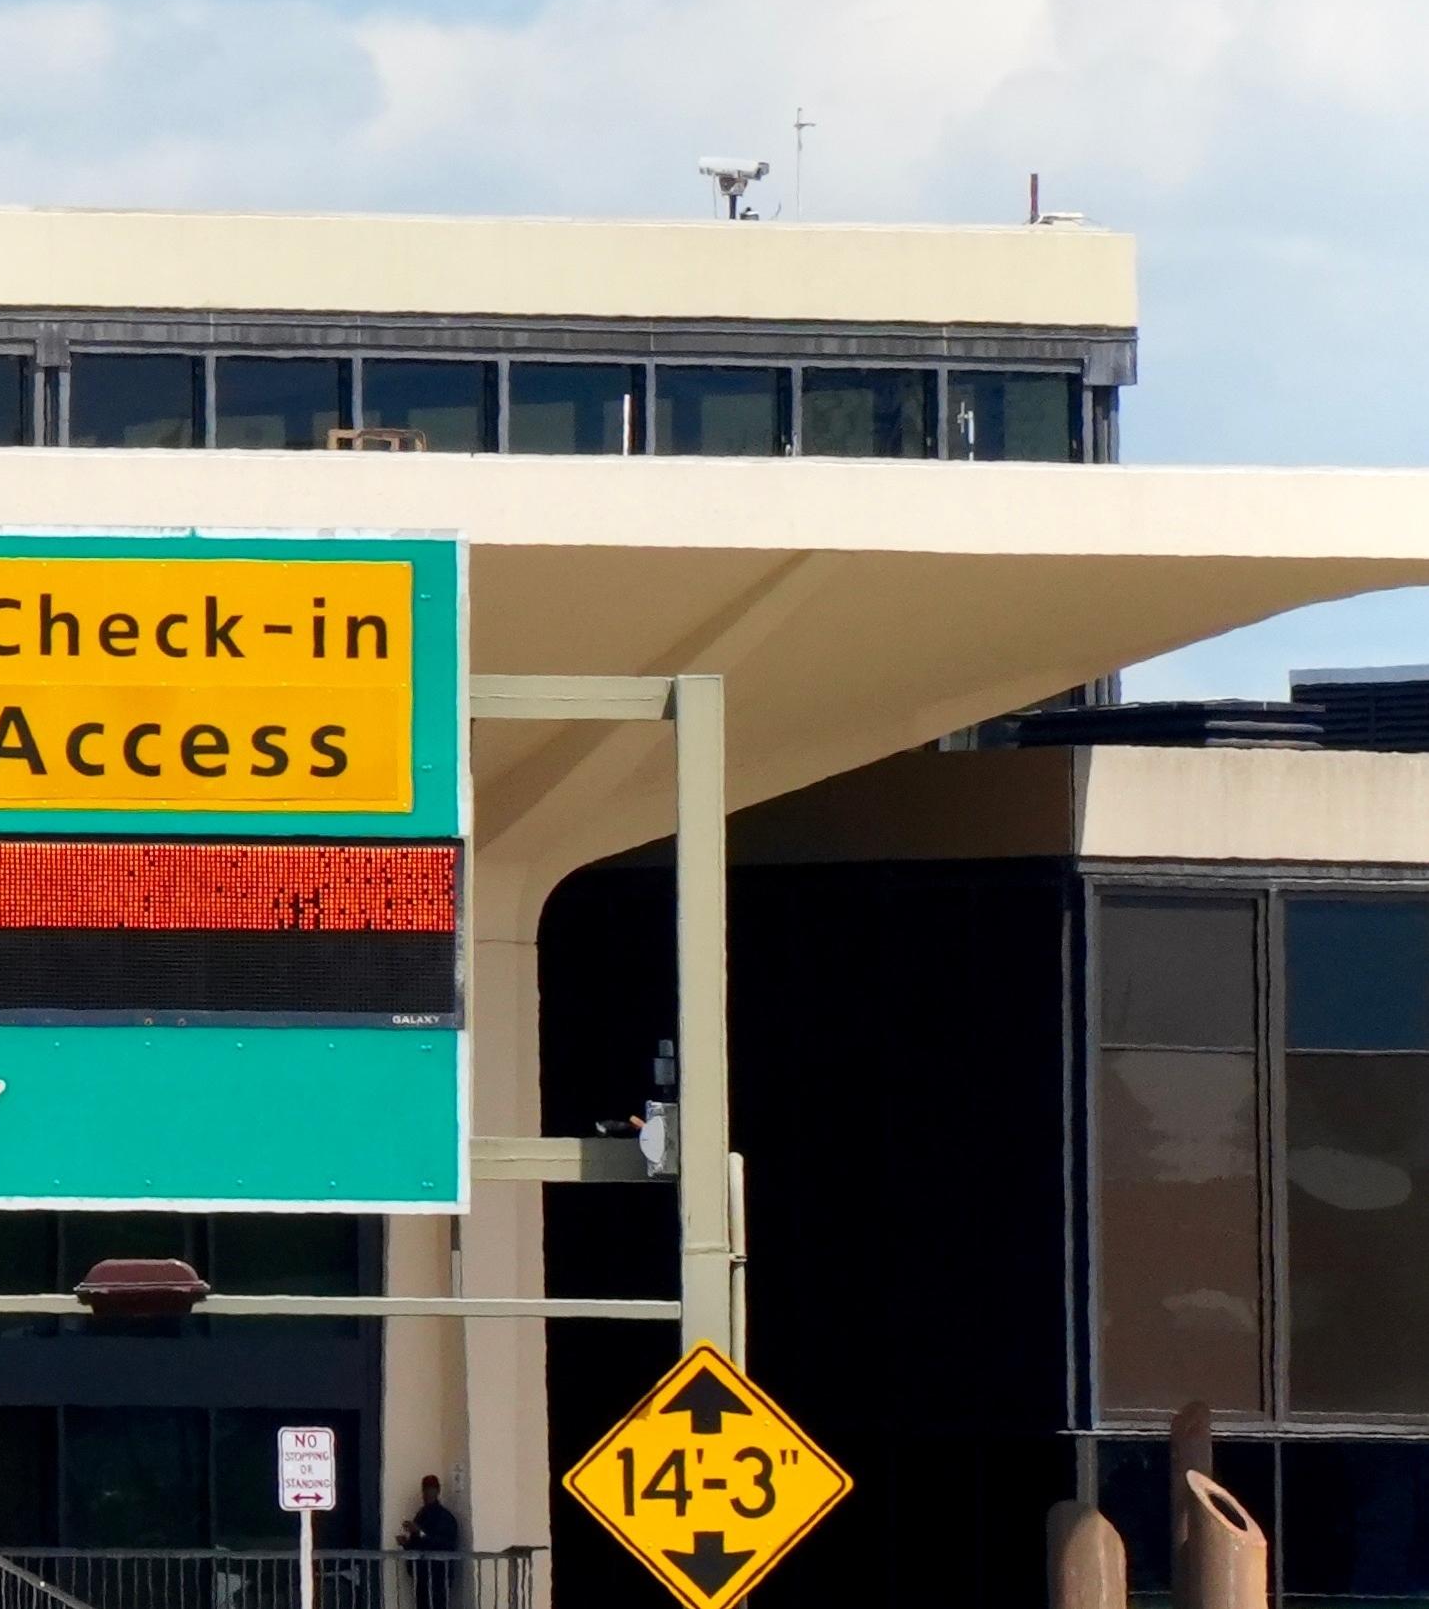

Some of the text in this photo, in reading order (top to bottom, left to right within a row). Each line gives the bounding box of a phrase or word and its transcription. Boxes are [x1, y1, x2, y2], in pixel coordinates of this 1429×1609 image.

[392, 1015, 440, 1025] GALAXY
[295, 1434, 317, 1449] NO
[616, 1446, 799, 1519] 14'-3"
